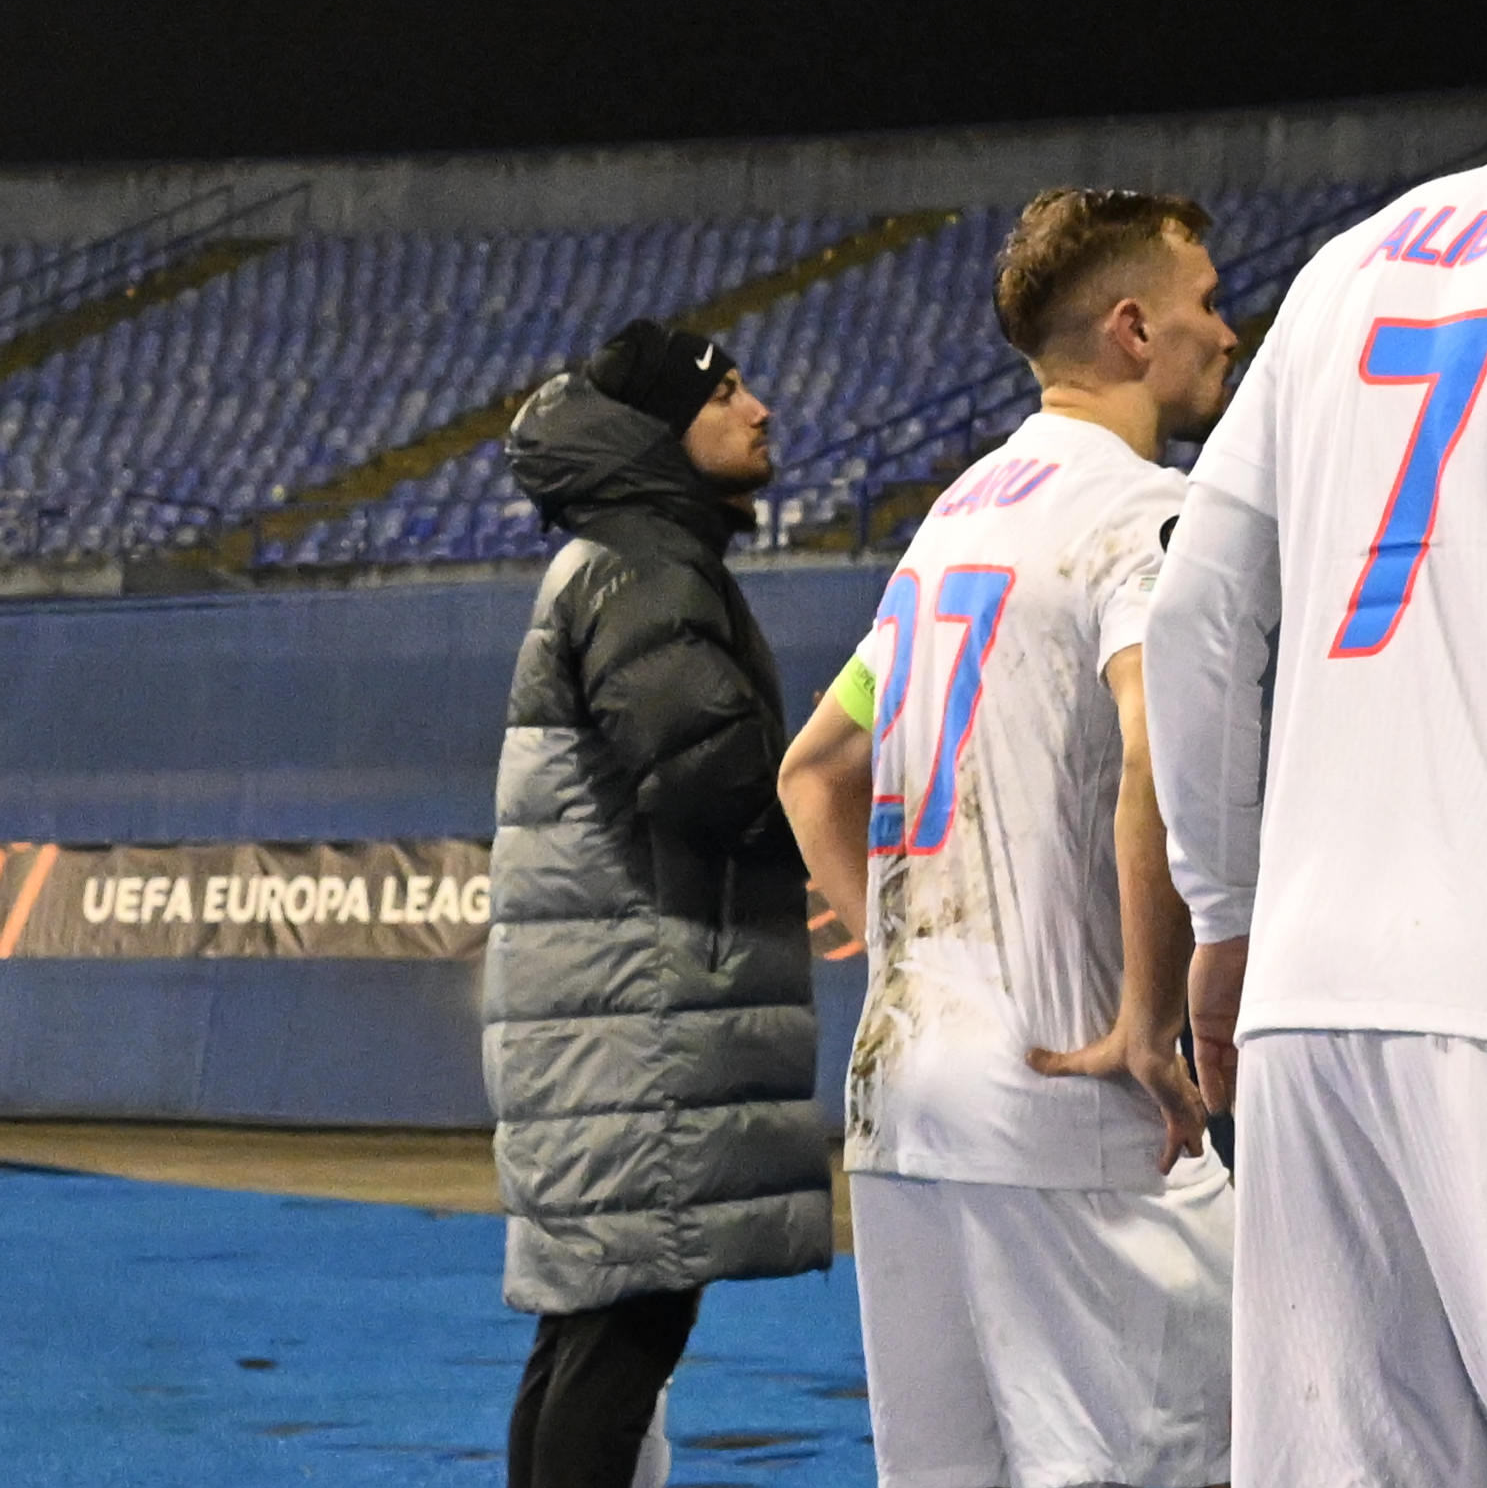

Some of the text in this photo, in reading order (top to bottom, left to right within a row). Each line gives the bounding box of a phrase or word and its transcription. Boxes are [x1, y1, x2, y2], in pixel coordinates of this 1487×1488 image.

[82, 875, 491, 924] UEFA EUROPA LEAG
